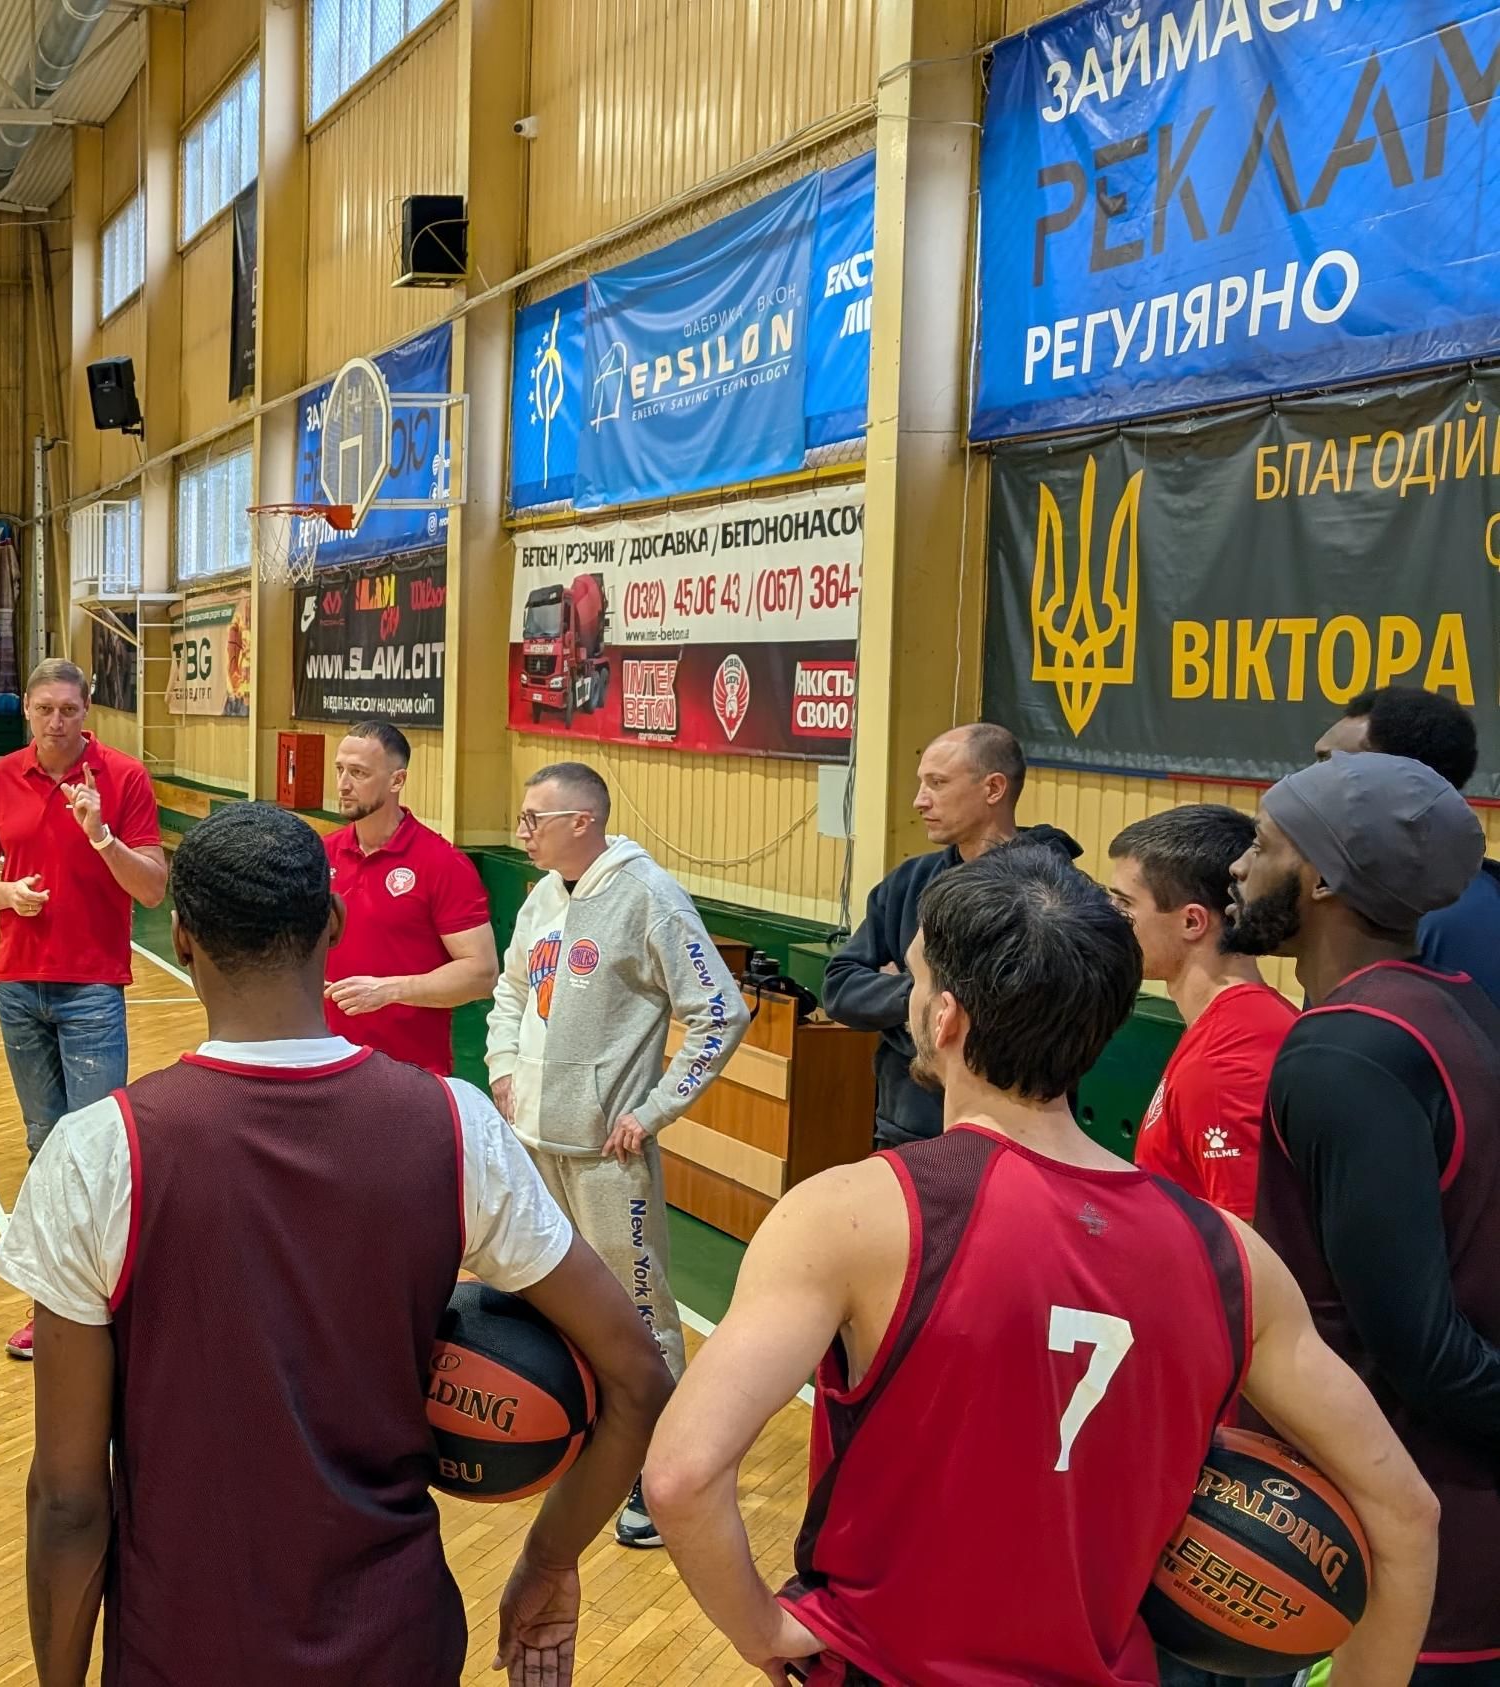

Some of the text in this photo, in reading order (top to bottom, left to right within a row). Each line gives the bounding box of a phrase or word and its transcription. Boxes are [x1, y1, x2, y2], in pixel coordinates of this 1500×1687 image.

[683, 304, 743, 338] ФАБРИКА
[1023, 250, 1360, 384] РЕГУЛЯРНО
[630, 309, 794, 400] EPSILON
[632, 363, 790, 421] ENERGY SAVING TECHNOLOGY
[1255, 400, 1500, 500] БЛАГОДІЙ
[629, 528, 708, 565] ДОСАВКА
[809, 562, 862, 609] 364-
[172, 637, 212, 681] TBG
[1171, 612, 1476, 706] ВІКТОРА
[796, 669, 855, 697] ЯКІСТЬ
[623, 696, 677, 731] BETON
[796, 701, 849, 730] СВОЮ
[676, 942, 729, 1097] New Yok Knicks
[1203, 1148, 1241, 1159] KELME
[629, 1199, 647, 1248] New
[633, 1254, 653, 1298] York
[1047, 1304, 1135, 1472] 7
[1185, 1572, 1280, 1632] 1000
[1208, 1601, 1226, 1618] GAME
[1227, 1611, 1246, 1629] BALL
